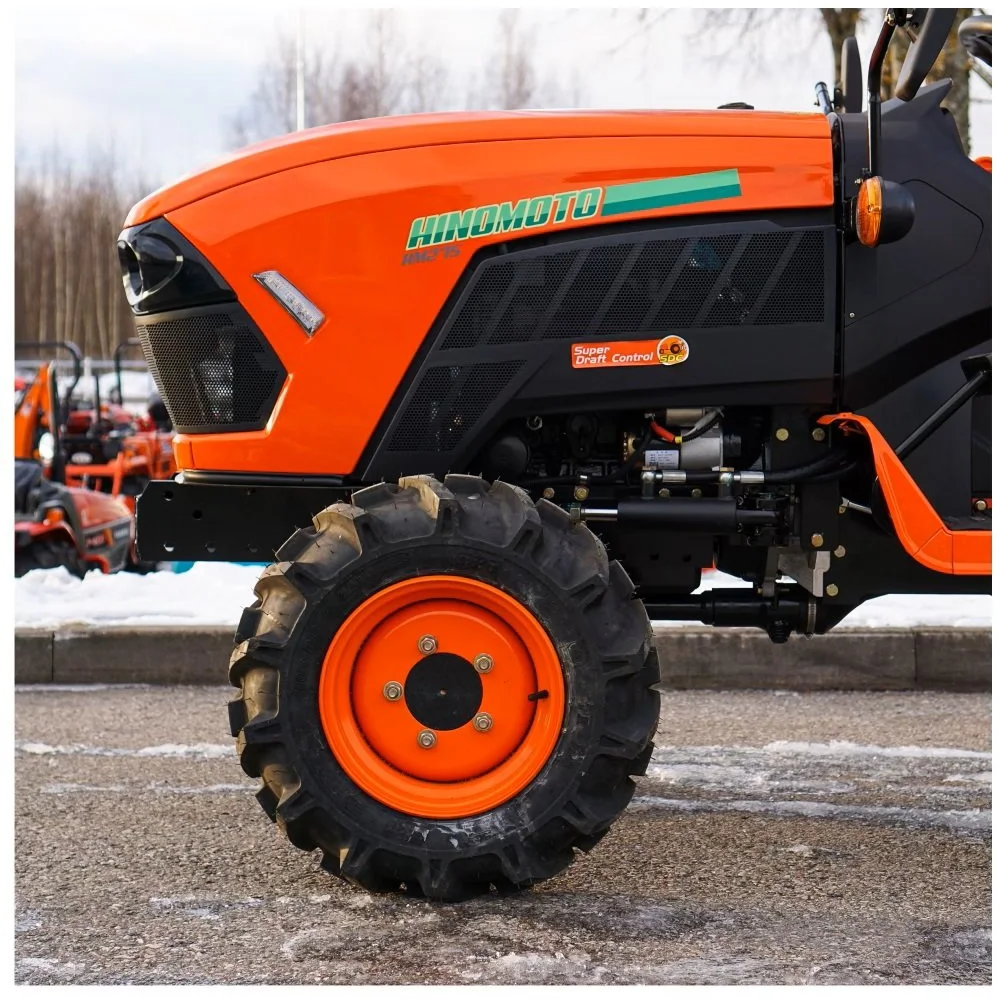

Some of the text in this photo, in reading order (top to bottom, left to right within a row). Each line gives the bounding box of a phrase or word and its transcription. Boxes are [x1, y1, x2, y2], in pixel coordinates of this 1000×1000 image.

[406, 187, 603, 250] HINOMOTO
[574, 346, 610, 356] Super
[576, 352, 654, 364] Draft Control
[660, 354, 684, 363] SDC
